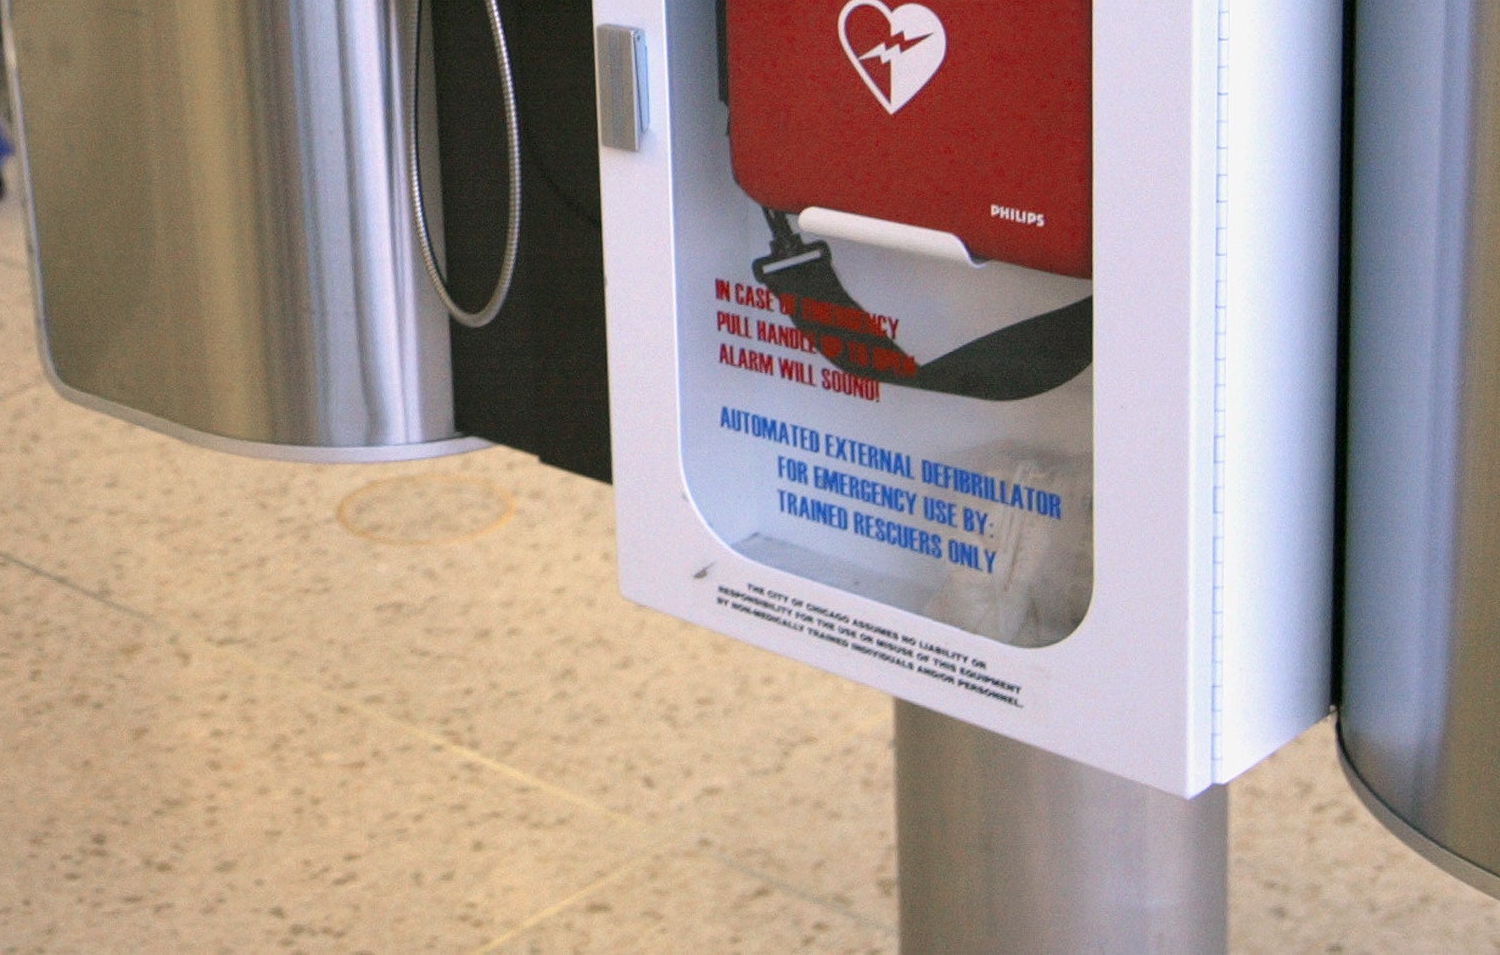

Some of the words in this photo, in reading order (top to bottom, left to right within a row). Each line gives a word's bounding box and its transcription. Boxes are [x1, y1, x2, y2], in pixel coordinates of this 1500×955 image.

[990, 204, 1045, 228] PHILIPS
[715, 278, 730, 302] IN
[735, 283, 774, 312] CASE
[717, 310, 752, 339] PULL
[757, 319, 817, 355] HANDLE
[719, 343, 774, 376] ALARM
[778, 357, 817, 387] WILL
[821, 367, 881, 402] SOUND!
[720, 406, 820, 453] AUTOMATED
[825, 433, 914, 479] EXTERNAL
[921, 459, 1062, 520] DEFIBRILLATOR
[777, 455, 808, 485] FOR
[813, 465, 917, 515] EMERGENCY
[923, 496, 958, 528] USE
[962, 506, 994, 539] BY:
[777, 489, 848, 531] TRAINED
[853, 511, 943, 559] RESCUERS
[948, 538, 997, 574] ONLY
[716, 596, 730, 607] BY
[807, 626, 849, 648] TRAINED
[718, 585, 793, 617] RESPONSIBILITY
[795, 611, 814, 624] FOR
[817, 618, 835, 631] THE
[838, 625, 857, 639] USE
[860, 632, 874, 644] OR
[876, 639, 914, 658] MISUSE
[916, 652, 930, 663] OF
[933, 657, 956, 673] THIS
[959, 666, 1022, 695] EQUIPMENT
[747, 583, 764, 595] THE
[767, 589, 789, 603] CITY
[791, 597, 804, 608] OF
[806, 603, 850, 624] CHICAGO
[852, 619, 899, 640] ASSUMES
[901, 635, 916, 646] NO
[919, 640, 969, 663] LIABILITY
[971, 658, 987, 670] OR
